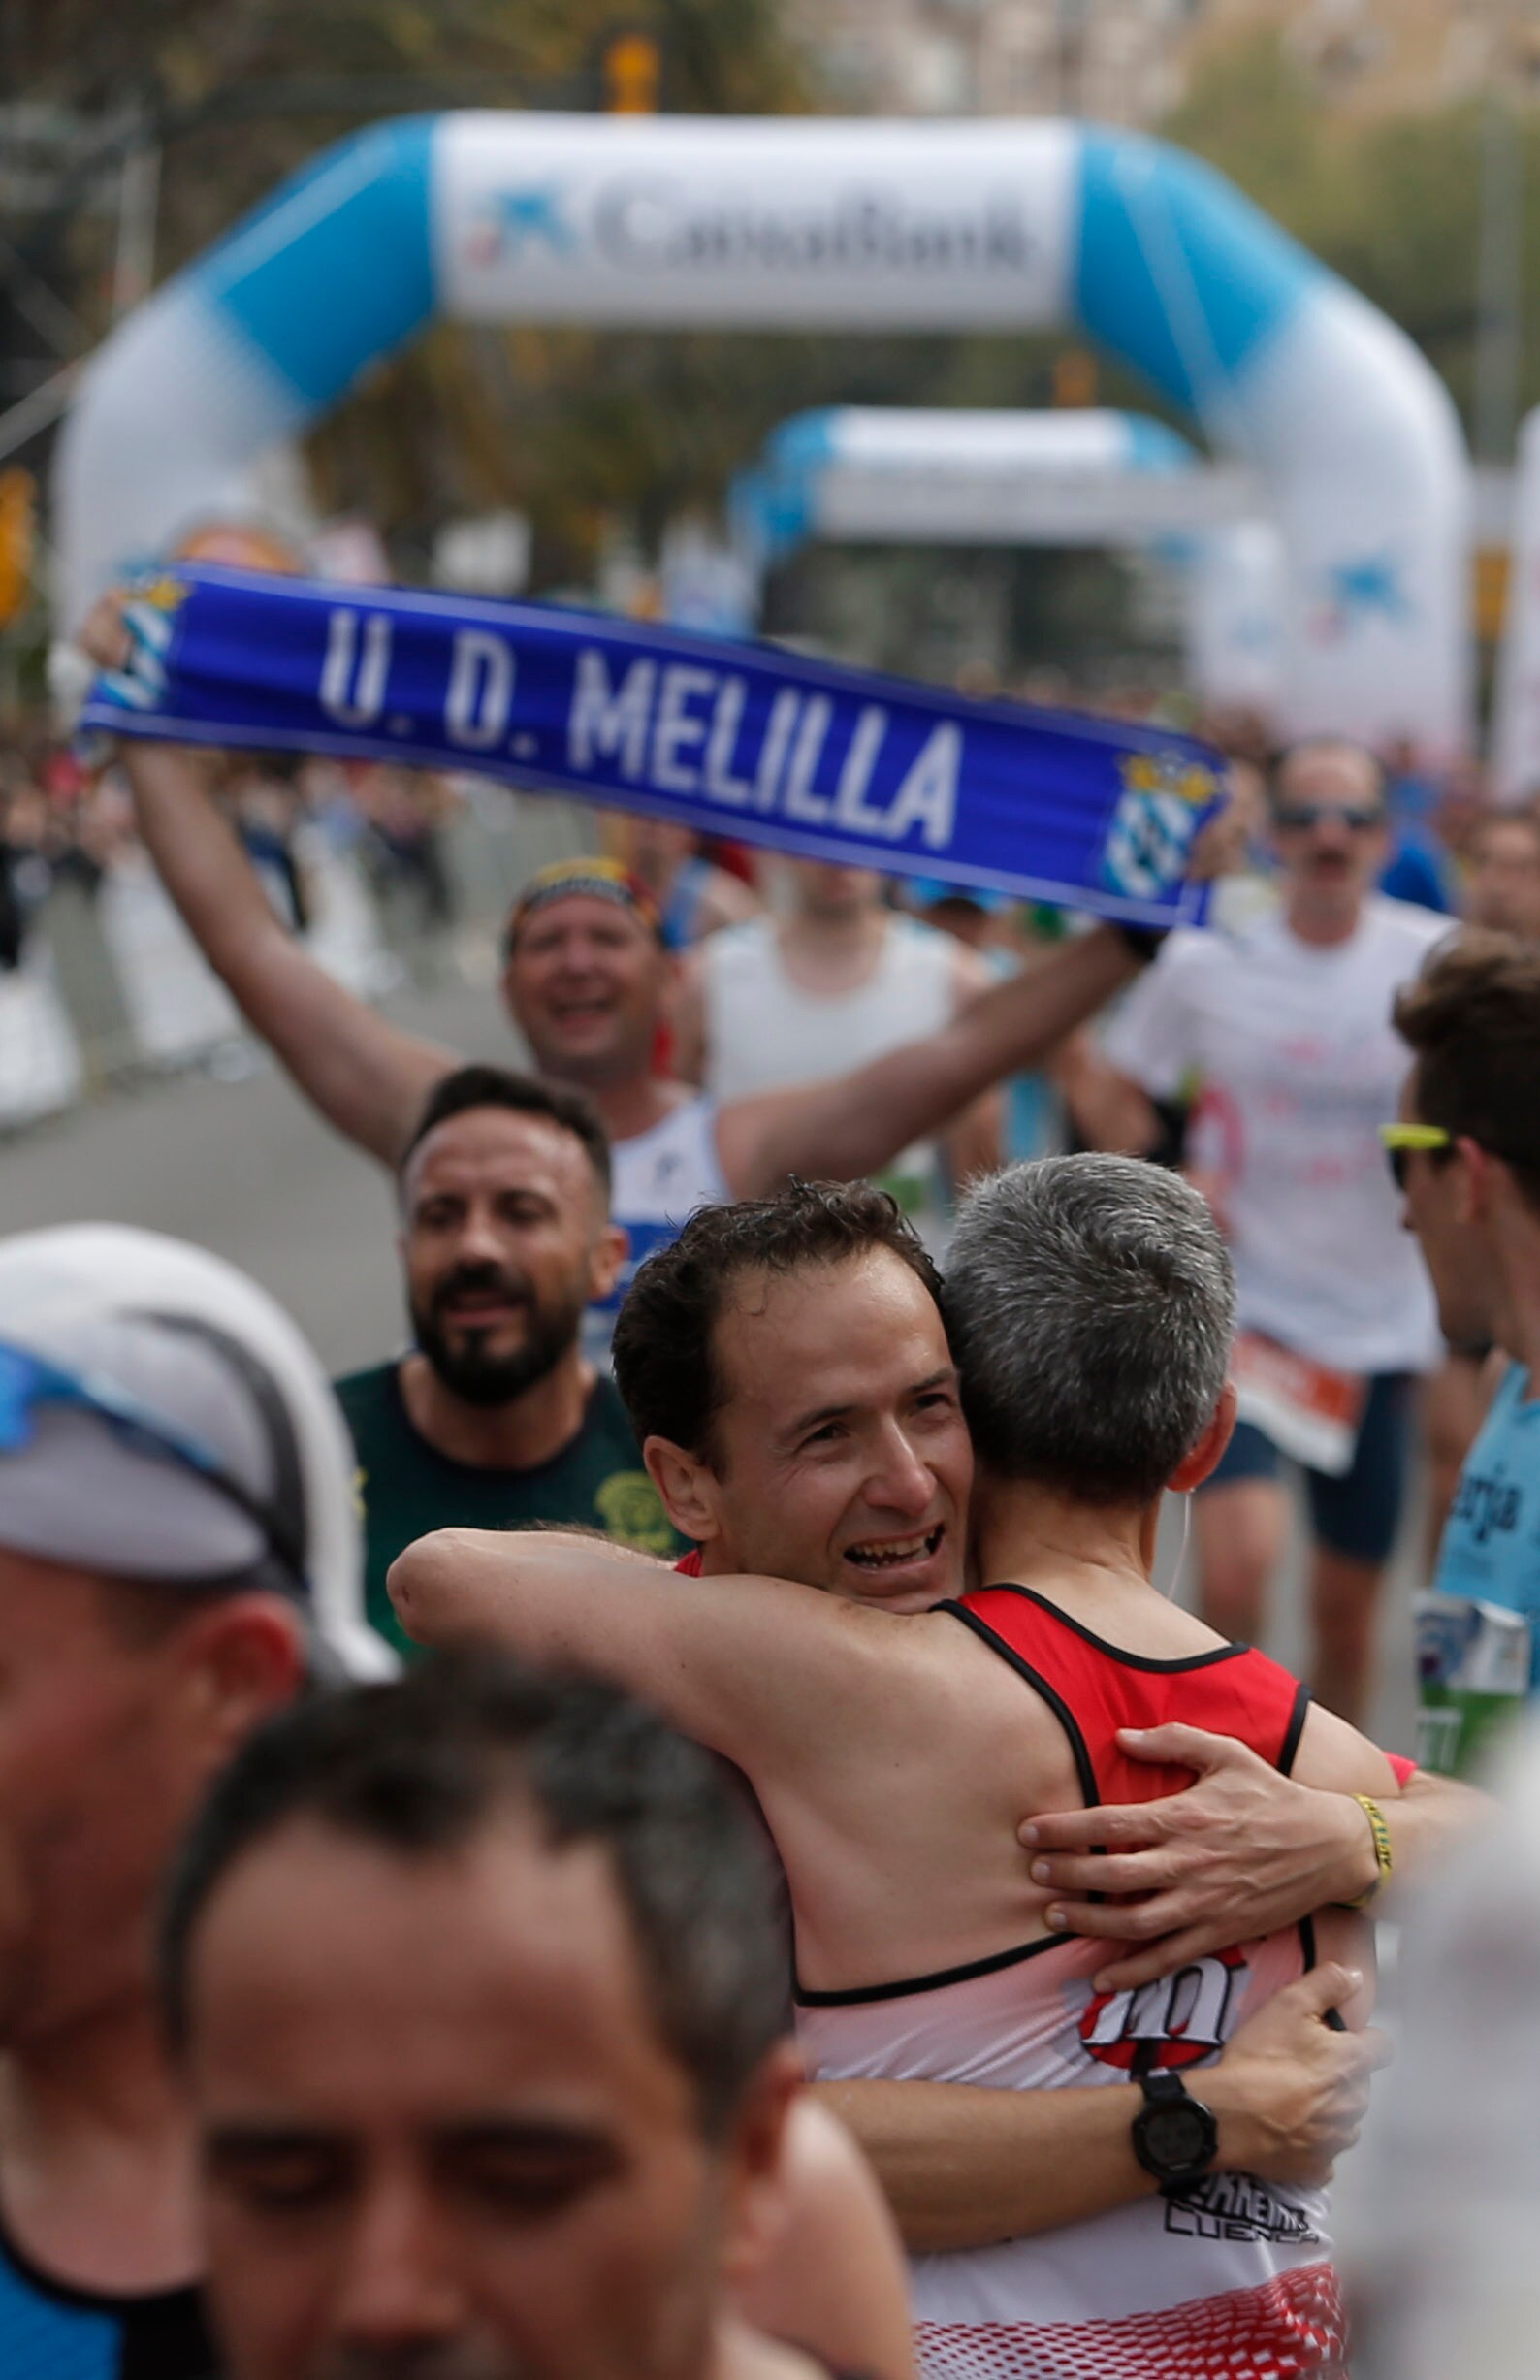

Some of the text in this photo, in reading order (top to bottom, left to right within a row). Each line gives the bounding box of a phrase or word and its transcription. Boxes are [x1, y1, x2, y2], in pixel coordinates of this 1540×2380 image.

[318, 608, 963, 851] U. D. MELILLA
